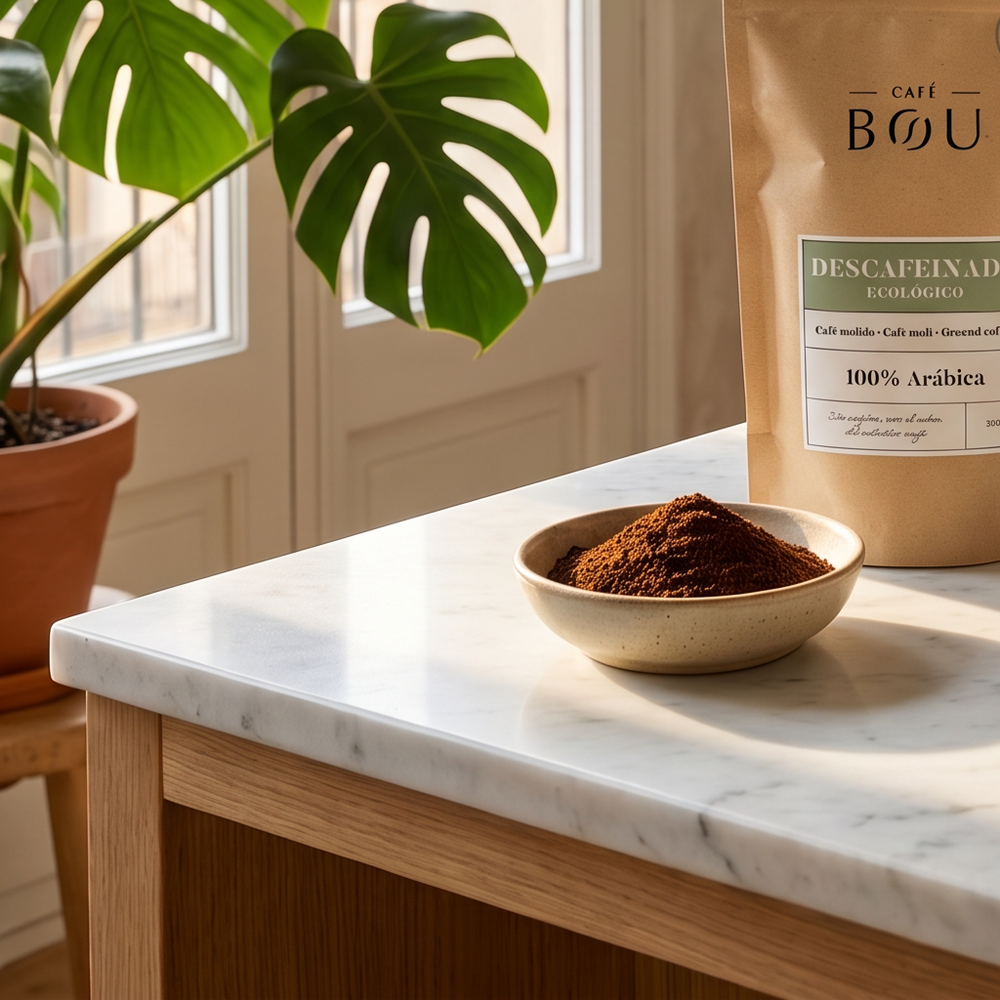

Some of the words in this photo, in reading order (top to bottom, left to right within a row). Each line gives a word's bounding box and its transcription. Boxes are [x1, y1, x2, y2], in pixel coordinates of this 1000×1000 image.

[891, 81, 936, 99] CAFÉ
[848, 108, 981, 151] BOU
[867, 283, 964, 299] ECOLÓGICO
[815, 325, 838, 336] Café
[840, 327, 875, 337] molido
[909, 327, 933, 337] moli
[846, 369, 900, 387] 100%
[907, 369, 986, 387] Arábica
[986, 419, 1000, 428] 300
